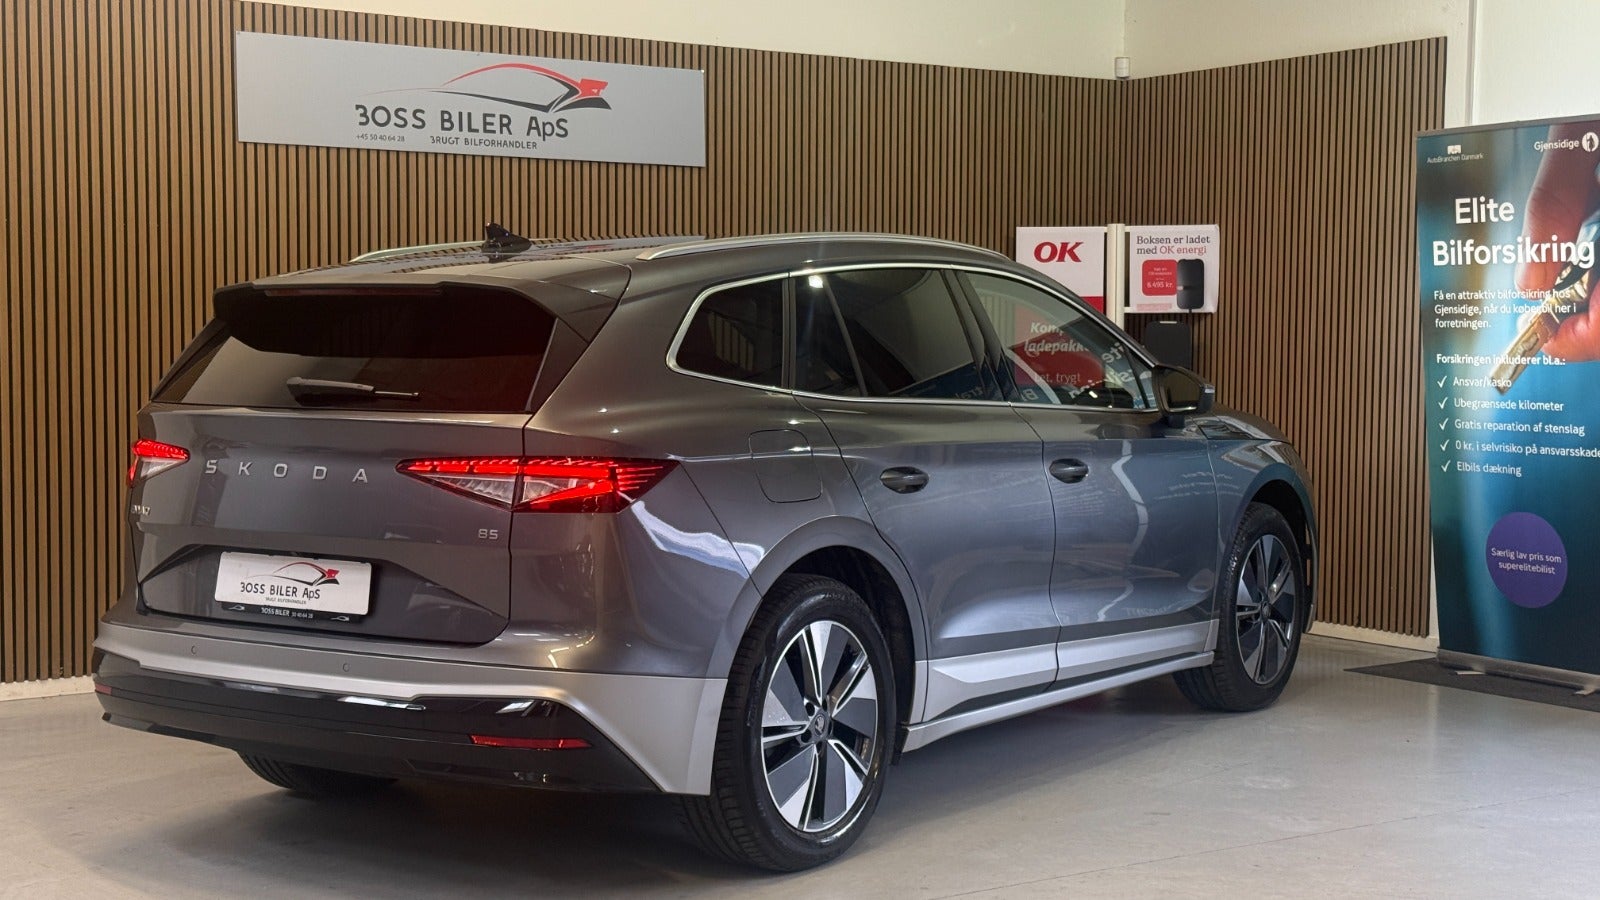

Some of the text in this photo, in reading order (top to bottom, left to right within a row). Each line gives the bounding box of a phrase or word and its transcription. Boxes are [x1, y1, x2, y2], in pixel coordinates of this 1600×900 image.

[440, 110, 512, 135] BILER
[526, 116, 569, 141] ApS
[464, 138, 538, 149] BILFORHANDLER
[1533, 138, 1580, 152] Gjensidige
[1455, 195, 1515, 225] Elite
[1136, 234, 1211, 245] Boksen er ladet
[1033, 241, 1084, 263] OK
[1136, 245, 1207, 256] med OK energi
[1432, 234, 1596, 268] Bilforsikring
[1434, 288, 1571, 301] Få en attraktiv bilforsikring hos
[1434, 304, 1482, 316] Gjensidige,
[1483, 304, 1498, 314] når
[1500, 304, 1512, 314] du
[1554, 303, 1572, 313] her
[1573, 302, 1577, 313] i
[1435, 318, 1492, 330] forretningen.
[1436, 353, 1493, 366] Forsikringen
[1493, 355, 1542, 366] inkluderer
[1452, 376, 1512, 387] Ansvar/kasko
[1454, 398, 1564, 412] Ubegrænsede kilometer
[1454, 418, 1585, 437] Gratis reparation af stenslag
[1455, 440, 1462, 450] 0
[1462, 440, 1475, 450] kr.
[1481, 441, 1523, 453] selvrisiko
[1525, 444, 1538, 456] på
[1456, 461, 1522, 478] Elbils dækning
[478, 528, 499, 540] 85
[1491, 547, 1562, 563] Særlig lav pris som
[1498, 561, 1556, 574] superelitebilist
[269, 584, 298, 598] BILER
[302, 587, 321, 601] ApS
